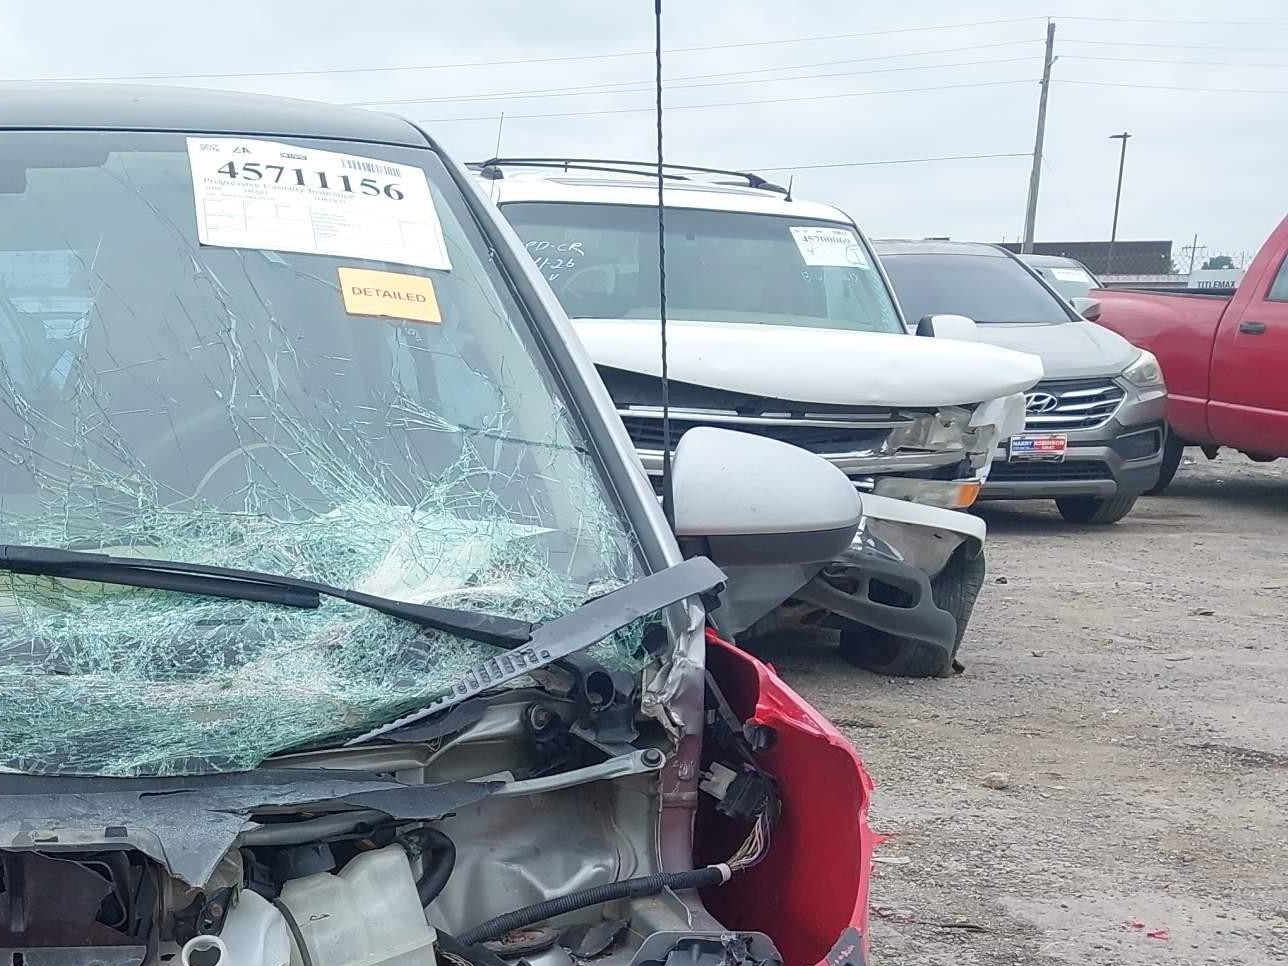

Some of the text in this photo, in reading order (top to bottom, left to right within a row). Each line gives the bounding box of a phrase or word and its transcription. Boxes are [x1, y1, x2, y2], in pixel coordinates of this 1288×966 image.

[217, 160, 405, 201] 45711156
[1197, 280, 1236, 289] TITLEMAX
[351, 286, 427, 304] DETAILED
